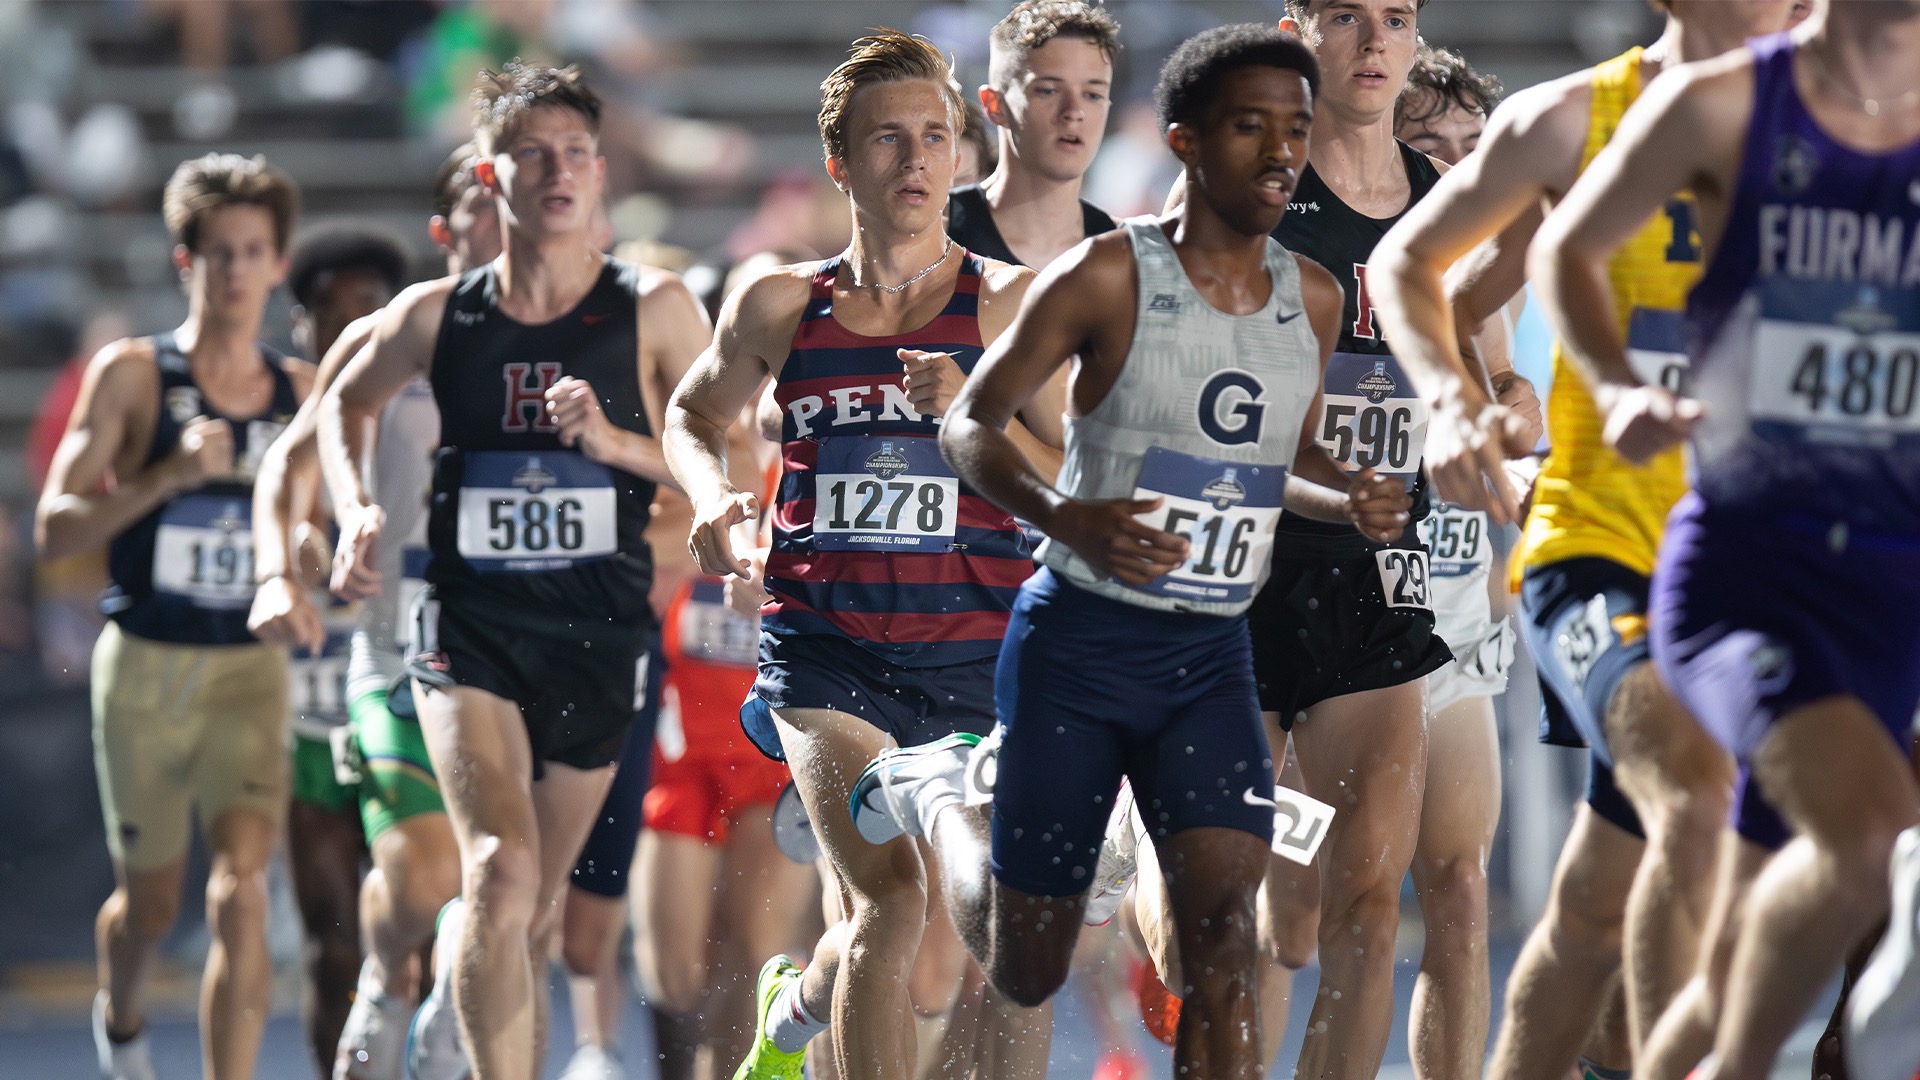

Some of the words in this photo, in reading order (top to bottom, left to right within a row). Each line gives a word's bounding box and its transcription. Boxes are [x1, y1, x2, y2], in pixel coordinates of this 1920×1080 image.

[502, 362, 562, 433] H
[1790, 342, 1918, 418] 480
[787, 384, 944, 439] PEN
[1196, 367, 1271, 448] G
[1323, 404, 1412, 469] 596
[488, 497, 583, 551] 586
[829, 480, 944, 532] 1278
[847, 535, 893, 544] JACKSONVILLE,
[893, 536, 921, 545] FLORIDA
[1423, 516, 1480, 559] 359
[1385, 552, 1427, 605] 29
